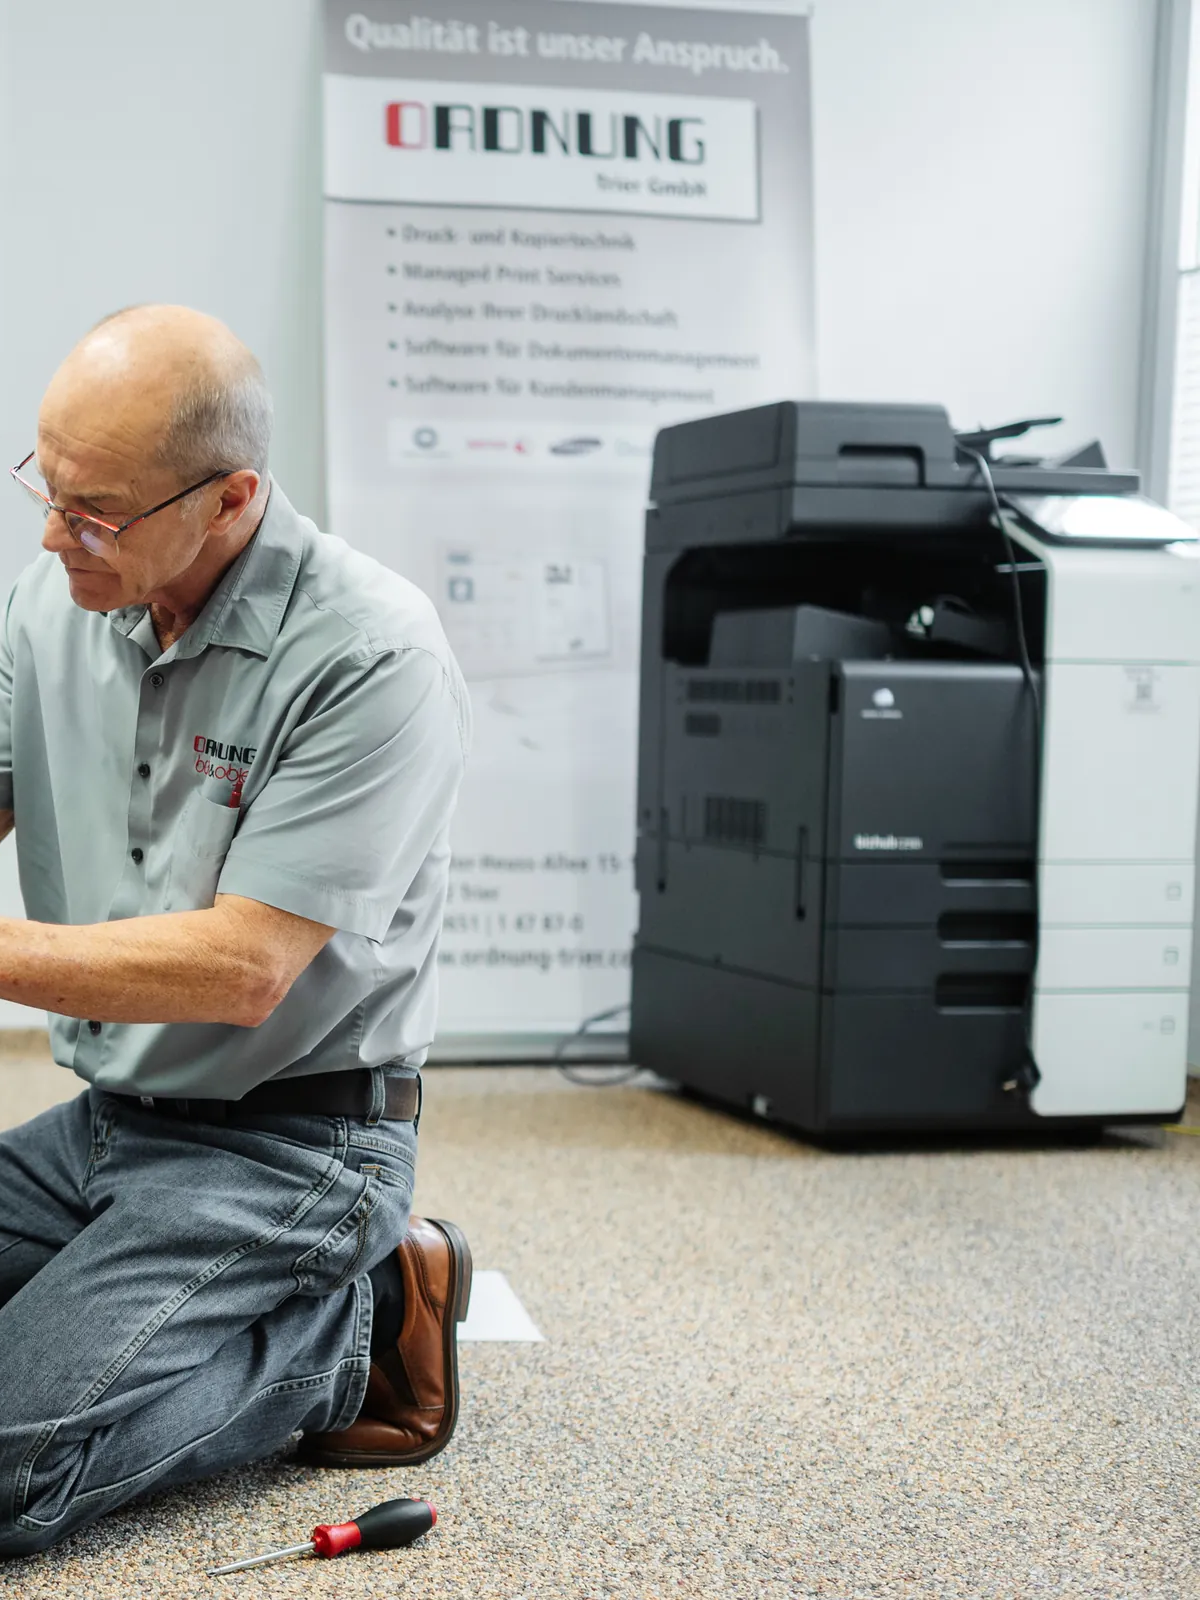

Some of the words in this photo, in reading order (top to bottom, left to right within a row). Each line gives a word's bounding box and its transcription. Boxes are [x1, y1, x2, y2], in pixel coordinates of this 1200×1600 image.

[345, 13, 478, 54] Qualität
[487, 21, 529, 57] ist
[537, 33, 624, 62] unser
[633, 33, 790, 75] Anspruch.
[384, 101, 706, 164] ORDNUNG
[597, 172, 641, 194] Trier
[649, 177, 707, 197] GmbH
[469, 230, 505, 246] und
[512, 230, 637, 252] Kopiertechnik
[403, 265, 490, 287] Managed
[497, 267, 540, 285] Print
[548, 269, 621, 288] Services
[404, 302, 474, 323] Analyse
[482, 304, 525, 321] Ihrer
[532, 305, 679, 329] Drucklandschaft
[406, 340, 489, 358] Software
[496, 341, 522, 358] für
[529, 344, 761, 371] Dokumentenmanagement
[406, 378, 490, 396] Software
[497, 379, 522, 396] für
[530, 380, 715, 405] Kundenmanagement
